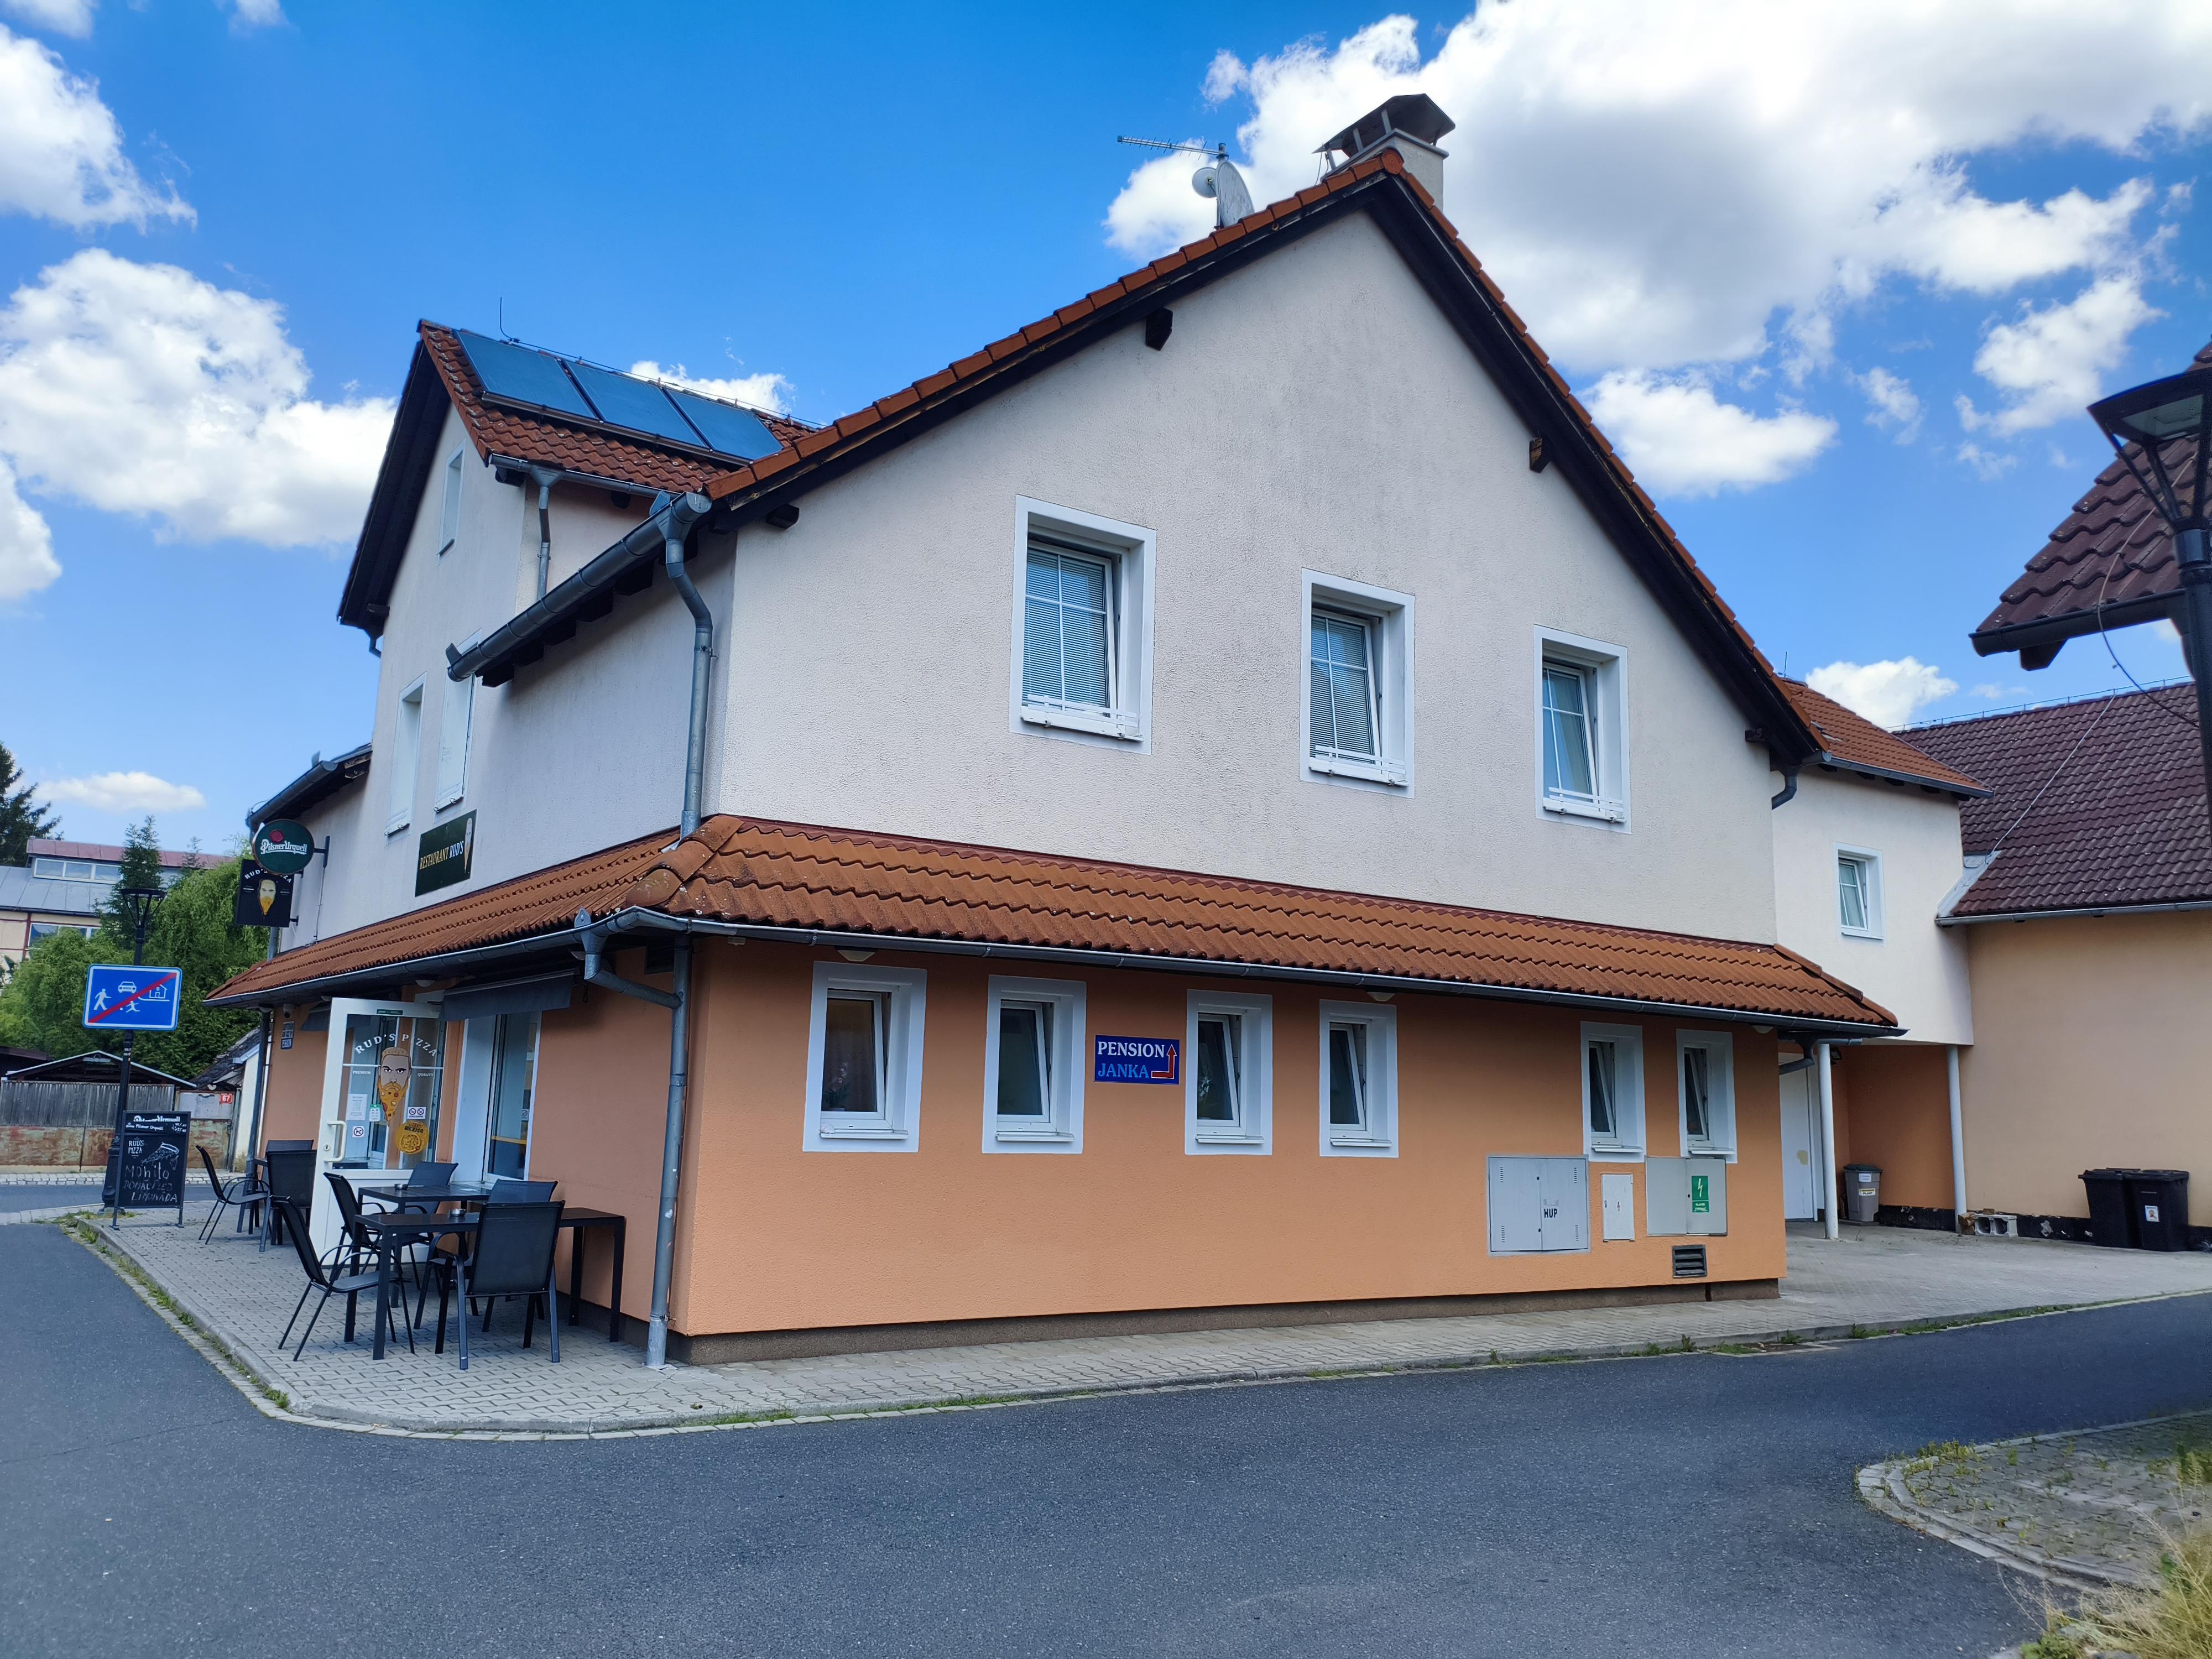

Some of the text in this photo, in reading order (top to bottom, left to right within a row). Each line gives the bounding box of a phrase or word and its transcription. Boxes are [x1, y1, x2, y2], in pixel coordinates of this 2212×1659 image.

[260, 839, 307, 854] Pilsner Urquell
[419, 841, 464, 870] RESTAURANT RUD'S
[354, 1033, 437, 1057] RUD'S PZZA
[1098, 1041, 1165, 1057] PENSION
[1098, 1063, 1149, 1078] JANKA
[1543, 1208, 1558, 1218] HUP
